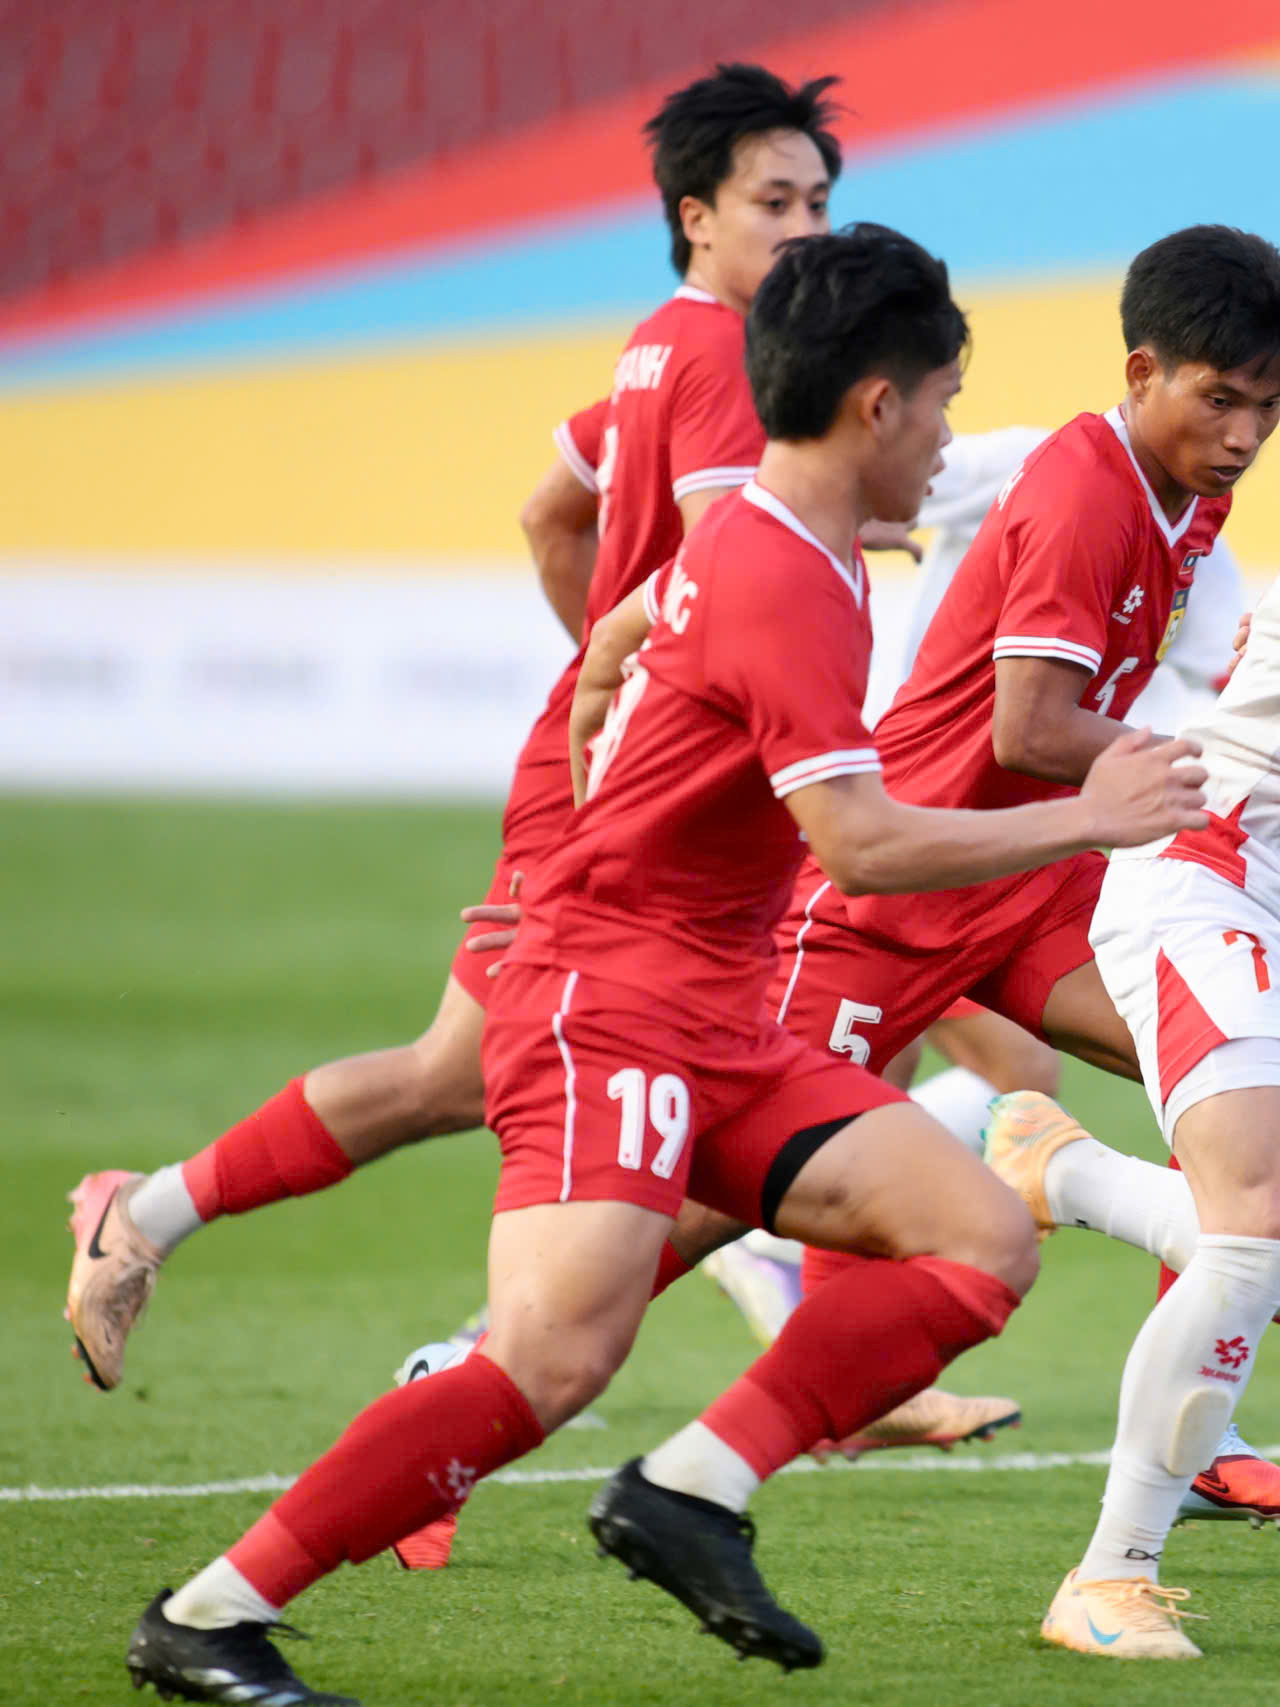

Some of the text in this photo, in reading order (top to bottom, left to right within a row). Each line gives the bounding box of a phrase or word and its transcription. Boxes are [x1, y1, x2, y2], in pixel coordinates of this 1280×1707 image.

[1222, 927, 1271, 993] 7
[829, 998, 882, 1067] 5
[607, 1067, 690, 1179] 19
